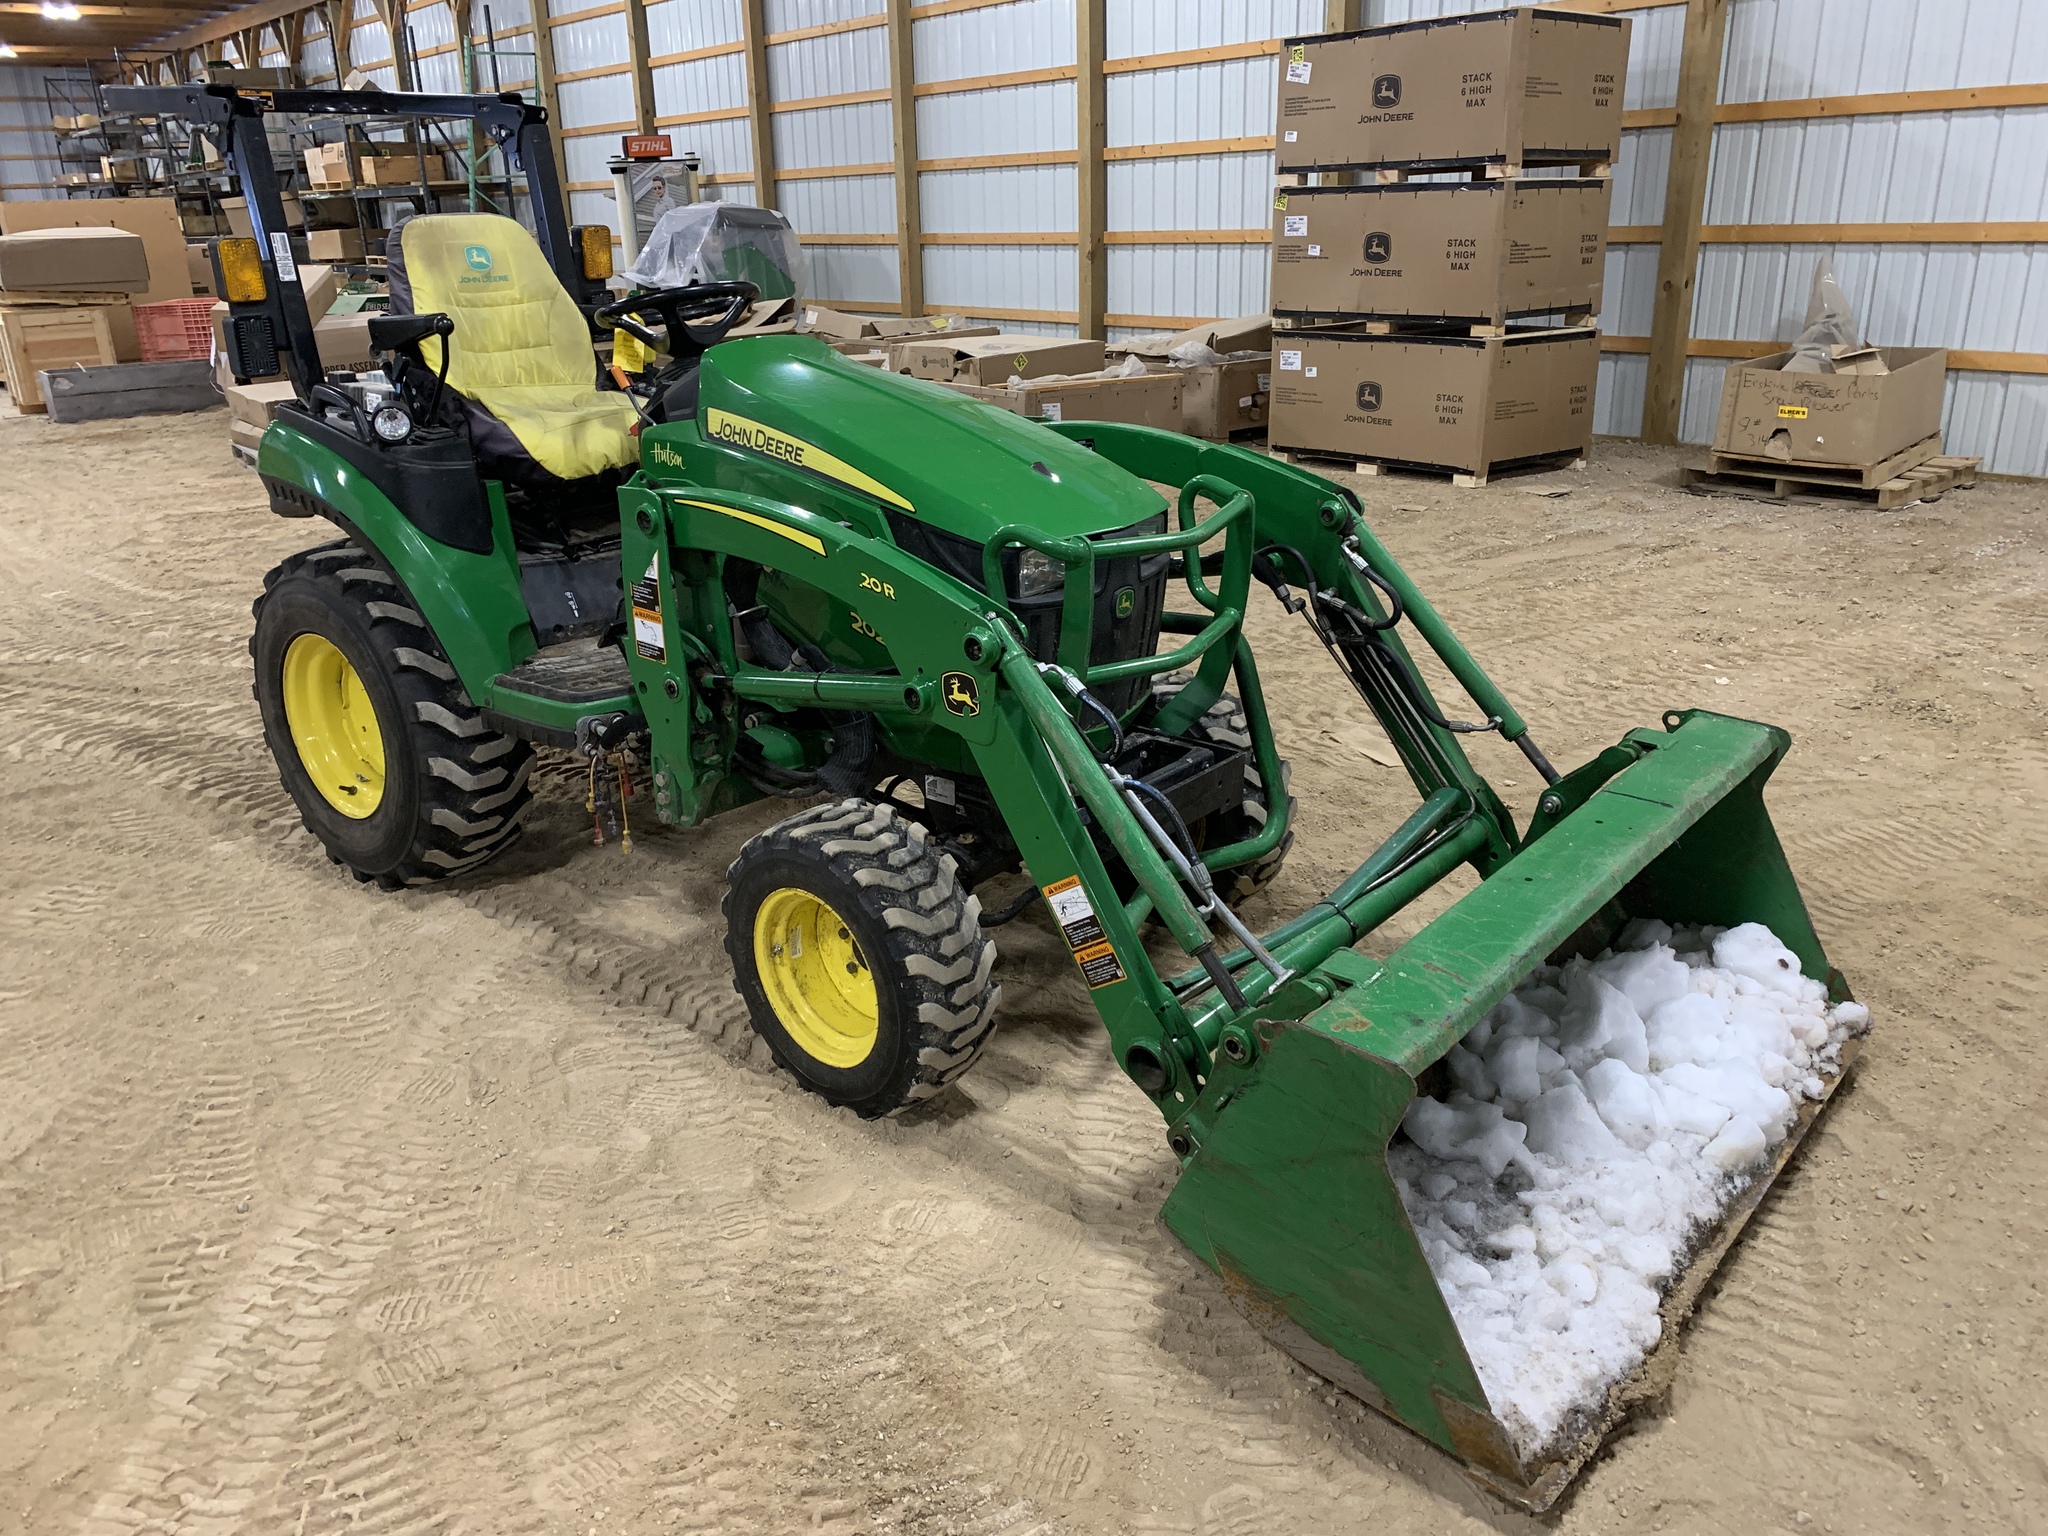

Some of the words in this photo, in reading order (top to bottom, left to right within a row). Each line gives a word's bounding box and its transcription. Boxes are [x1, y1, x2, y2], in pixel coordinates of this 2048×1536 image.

[1462, 72, 1493, 84] STACK
[1594, 74, 1615, 84] STACK
[1461, 87, 1467, 96] 6
[1469, 85, 1492, 95] HIGH
[1592, 86, 1597, 95] 6
[1597, 86, 1614, 95] HIGH
[1466, 98, 1486, 108] MAX
[1595, 98, 1609, 107] MAX
[1357, 114, 1382, 124] JOHN
[1383, 112, 1414, 122] DEERE
[630, 141, 668, 152] STIHL
[1447, 239, 1476, 248] STACK
[1581, 234, 1598, 243] STACK
[1446, 251, 1451, 259] 6
[1453, 250, 1476, 259] HIGH
[1580, 246, 1584, 254] 6
[1584, 245, 1598, 254] HIGH
[1581, 256, 1593, 265] MAX
[1450, 262, 1470, 271] MAX
[1350, 267, 1373, 277] JOHN
[1374, 267, 1402, 277] DEERE
[459, 275, 481, 284] JOHN
[482, 275, 509, 283] DEERE
[366, 302, 381, 310] FIELD
[1570, 385, 1588, 394] STACK
[1436, 393, 1464, 403] STACK
[1569, 397, 1573, 405] 6
[1573, 395, 1587, 404] HIGH
[1434, 404, 1440, 412] 6
[1442, 405, 1463, 414] HIGH
[1570, 406, 1583, 415] MAX
[1343, 413, 1366, 424] JOHN
[1366, 415, 1393, 426] DEERE
[1438, 416, 1457, 425] MAX
[714, 418, 752, 446] JOHN
[755, 429, 805, 465] DEERE
[650, 442, 686, 470] Hutson
[639, 611, 661, 623] WARNING
[1053, 878, 1077, 892] WARNING
[1085, 946, 1110, 959] WARNING
